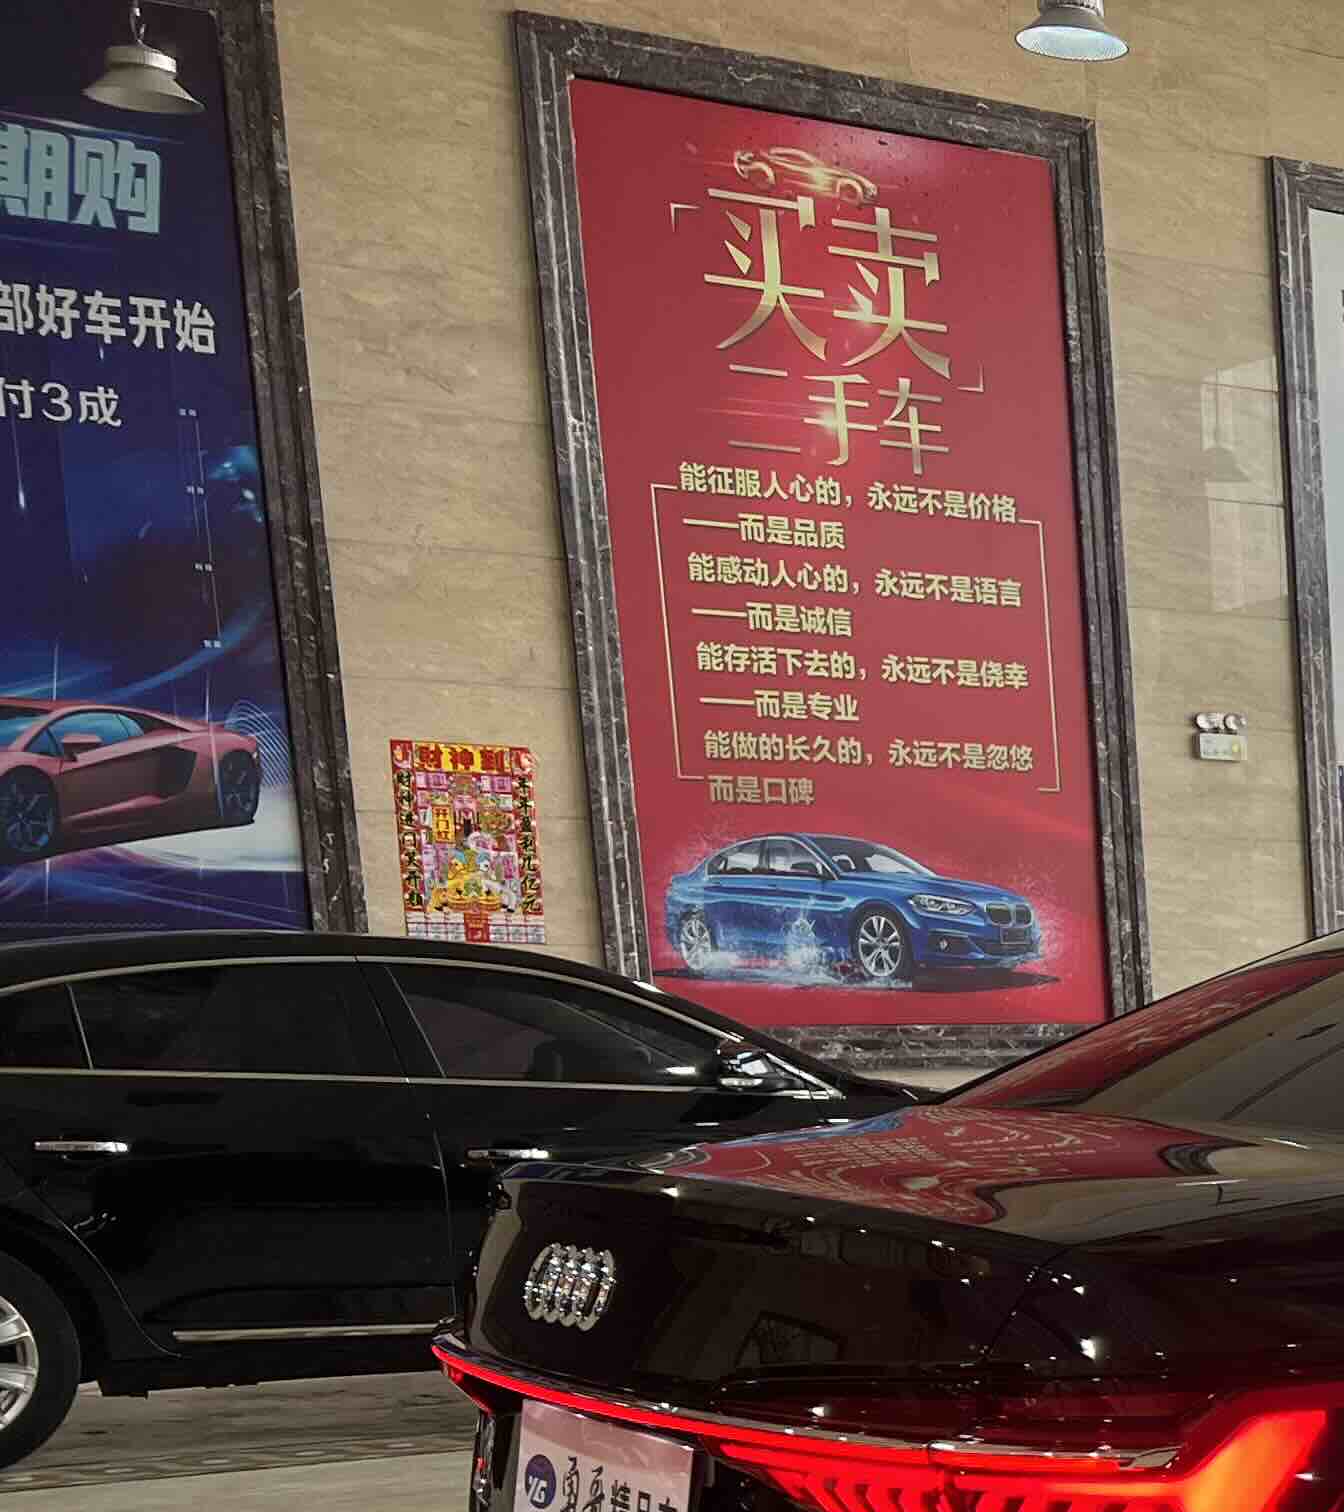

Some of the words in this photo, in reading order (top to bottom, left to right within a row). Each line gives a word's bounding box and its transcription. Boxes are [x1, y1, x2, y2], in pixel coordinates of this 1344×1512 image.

[0, 280, 217, 355] 部好车开始
[703, 188, 952, 380] 买卖
[728, 364, 950, 475] 二手车
[708, 775, 816, 806] 而是口碑
